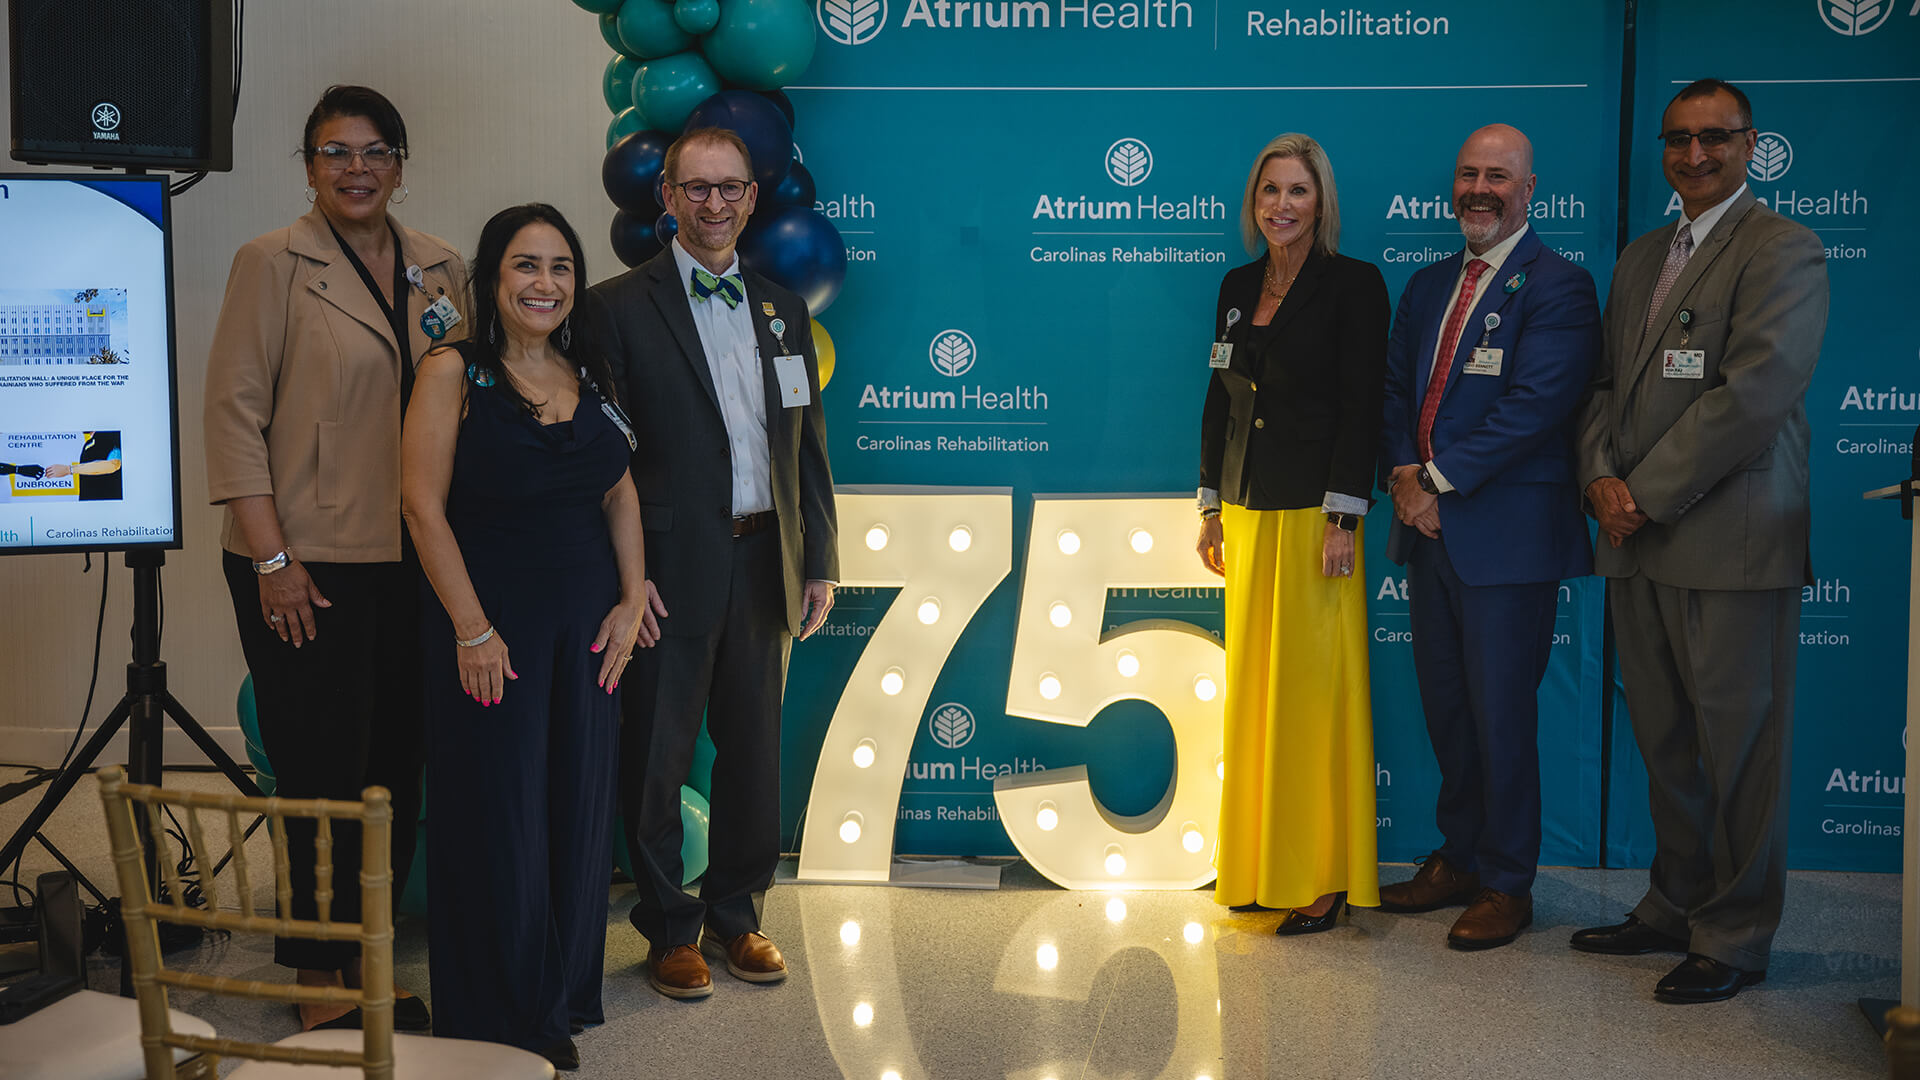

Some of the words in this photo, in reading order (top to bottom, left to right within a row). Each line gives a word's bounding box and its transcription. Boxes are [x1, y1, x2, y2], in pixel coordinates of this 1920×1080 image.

[902, 0, 1050, 28] Atrium
[1060, 0, 1193, 28] Health
[1247, 9, 1449, 36] Rehabilitation
[93, 132, 120, 141] YAMAHA
[813, 193, 875, 218] ealth
[1033, 195, 1131, 219] Atrium
[1138, 195, 1225, 220] Health
[1386, 195, 1456, 219] Atriu
[1775, 190, 1868, 215] Health
[1030, 247, 1106, 262] Carolinas
[1112, 247, 1226, 263] Rehabilitation
[1383, 247, 1457, 262] Carolina
[858, 385, 956, 409] Atrium
[962, 385, 1048, 410] Health
[1840, 385, 1920, 410] Atriu
[856, 435, 931, 451] Carolinas
[937, 436, 1049, 451] Rehabilitation
[16, 480, 72, 488] UNBROKEN
[46, 529, 98, 539] Carolinas
[1801, 578, 1850, 602] alth
[797, 487, 1227, 890] 75
[1825, 768, 1906, 793] Atriu
[1821, 818, 1901, 836] Carolinas
